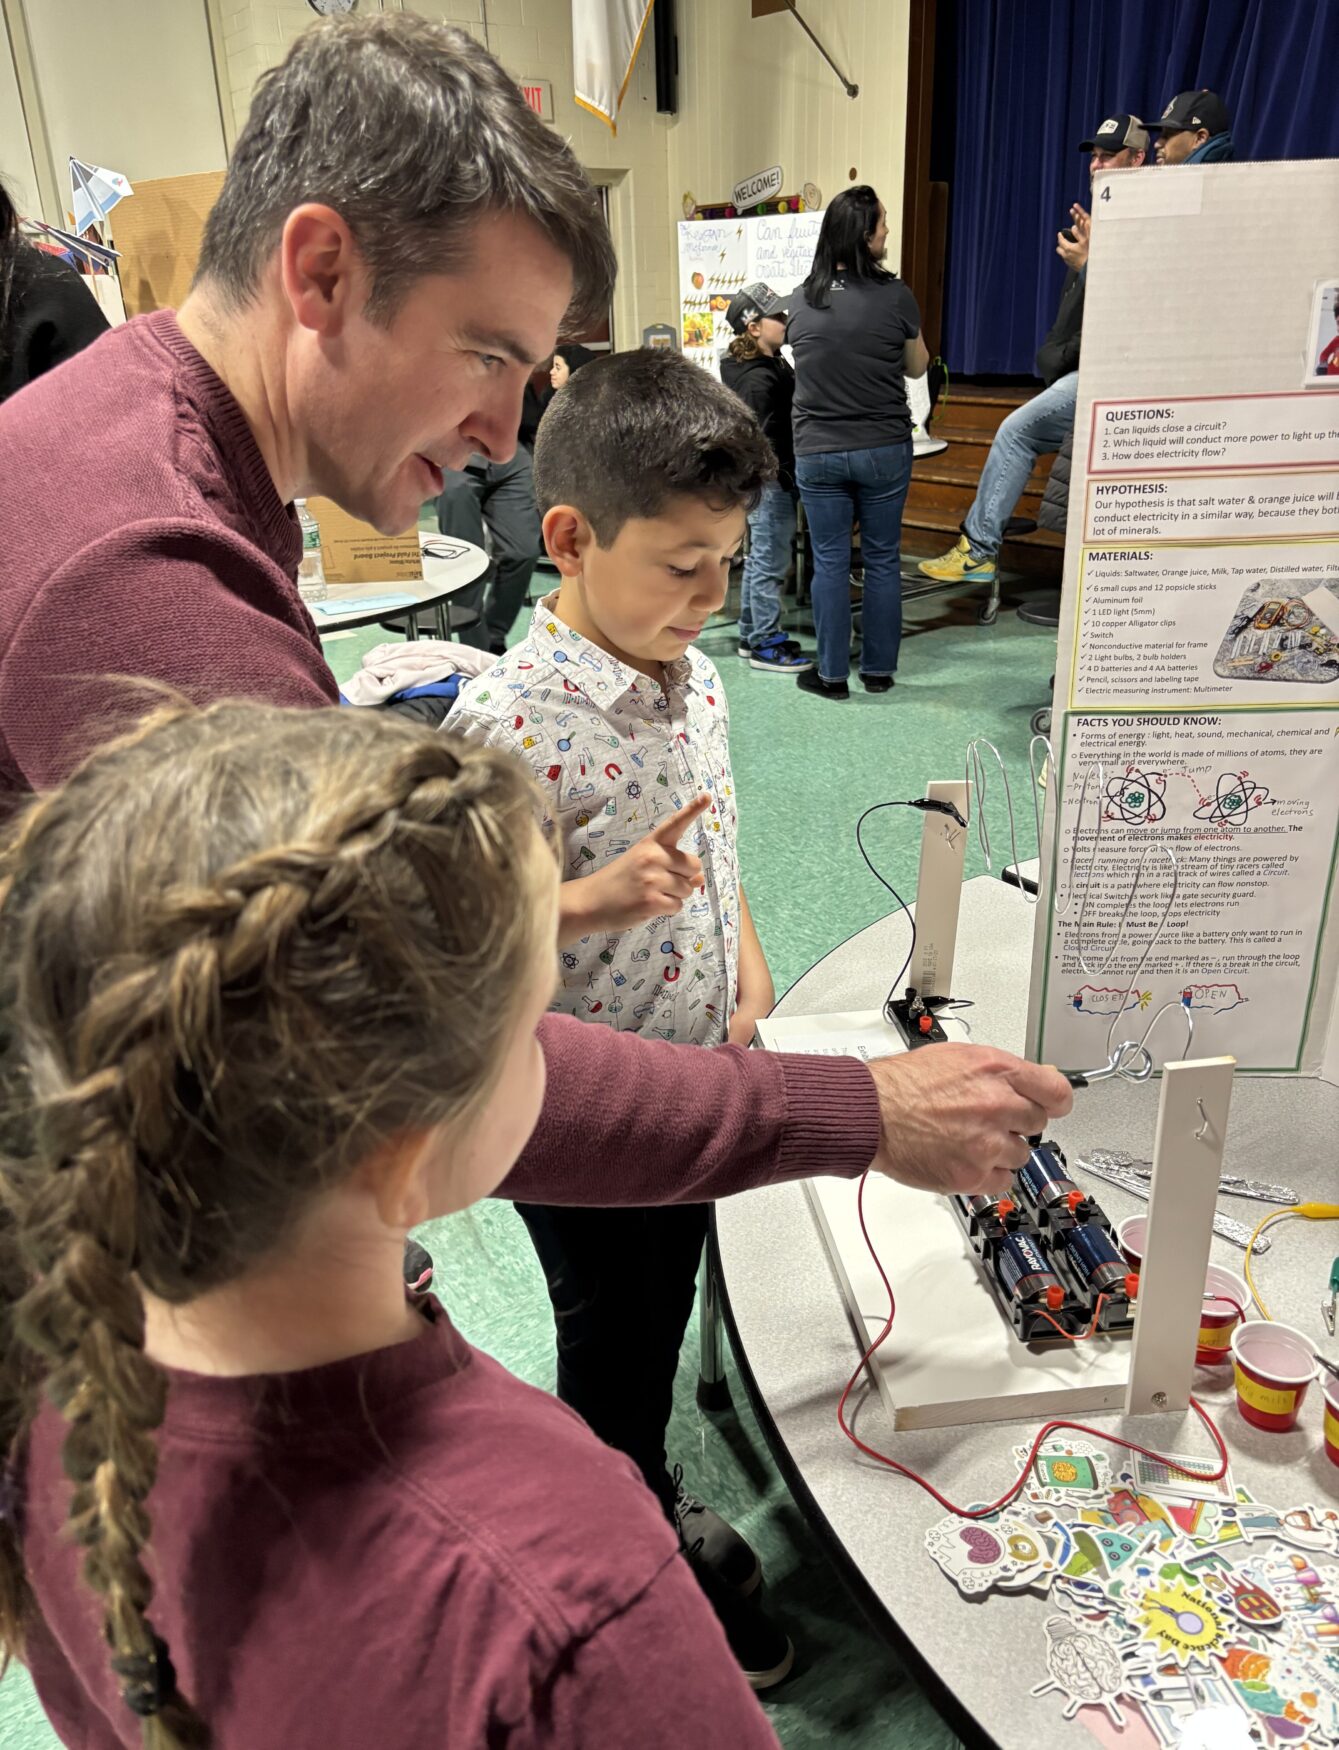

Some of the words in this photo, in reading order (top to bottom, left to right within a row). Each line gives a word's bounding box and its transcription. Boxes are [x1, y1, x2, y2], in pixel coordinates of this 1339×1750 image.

[523, 86, 543, 115] XIT
[734, 171, 780, 203] WELCOME!
[1101, 186, 1111, 202] 4
[757, 220, 783, 241] Can
[1106, 409, 1174, 422] QUESTIONS:
[1132, 425, 1160, 435] liquids
[1162, 424, 1184, 432] close
[1194, 422, 1227, 431] circuit?
[1113, 438, 1140, 447] Which
[1143, 437, 1166, 447] liquid
[1169, 436, 1184, 445] will
[1186, 435, 1221, 444] conduct
[1250, 435, 1278, 443] power
[1293, 431, 1312, 441] light
[1314, 432, 1325, 440] up
[1112, 452, 1131, 460] How
[1134, 451, 1154, 459] does
[1157, 449, 1199, 459] electricity
[1202, 448, 1226, 456] flow?
[1097, 484, 1167, 495] HYPOTHESIS:
[1095, 501, 1112, 509] Our
[1115, 499, 1164, 510] hypothesis
[1177, 498, 1196, 506] that
[1198, 497, 1215, 506] salt
[1218, 497, 1245, 505] water
[1248, 496, 1255, 504] &
[1258, 496, 1290, 505] orange
[1292, 493, 1315, 504] juice
[1318, 492, 1334, 501] will
[1094, 513, 1130, 522] conduct
[1133, 512, 1179, 522] electricity
[1181, 512, 1190, 520] in
[1200, 510, 1232, 519] similar
[1235, 512, 1254, 520] way,
[1258, 509, 1295, 517] because
[1299, 507, 1319, 516] they
[1093, 527, 1105, 535] lot
[1108, 526, 1117, 535] of
[1120, 526, 1161, 535] minerals.
[1089, 551, 1153, 561] MATERIALS:
[1095, 570, 1122, 578] Liquids:
[1162, 569, 1188, 577] Orange
[1131, 608, 1155, 616] (5mm)
[1095, 654, 1111, 662] Light
[1087, 676, 1109, 684] Pencil,
[1077, 719, 1108, 727] FACTS
[1112, 718, 1133, 726] YOU
[1136, 717, 1180, 726] SHOULD
[1183, 717, 1221, 725] KNOW:
[1153, 731, 1172, 739] light,
[1175, 731, 1194, 739] heat,
[1197, 731, 1224, 739] sound,
[1227, 730, 1274, 738] mechanical,
[1277, 728, 1312, 736] chemical
[1119, 739, 1146, 747] energy.
[1080, 752, 1121, 760] Everything
[1290, 748, 1307, 756] they
[1138, 759, 1187, 767] everywhere.
[1181, 765, 1212, 775] Jump
[1276, 799, 1310, 809] moving
[1271, 806, 1314, 816] electrons
[1253, 825, 1287, 833] another.
[1193, 833, 1235, 841] electricity.
[1213, 856, 1236, 864] things
[1253, 855, 1287, 863] powered
[1167, 920, 1188, 928] Loop!
[1194, 988, 1228, 1000] OPEN
[1015, 1236, 1042, 1271] RAYOVAC
[1181, 1591, 1226, 1631] National
[1157, 1629, 1181, 1647] Day
